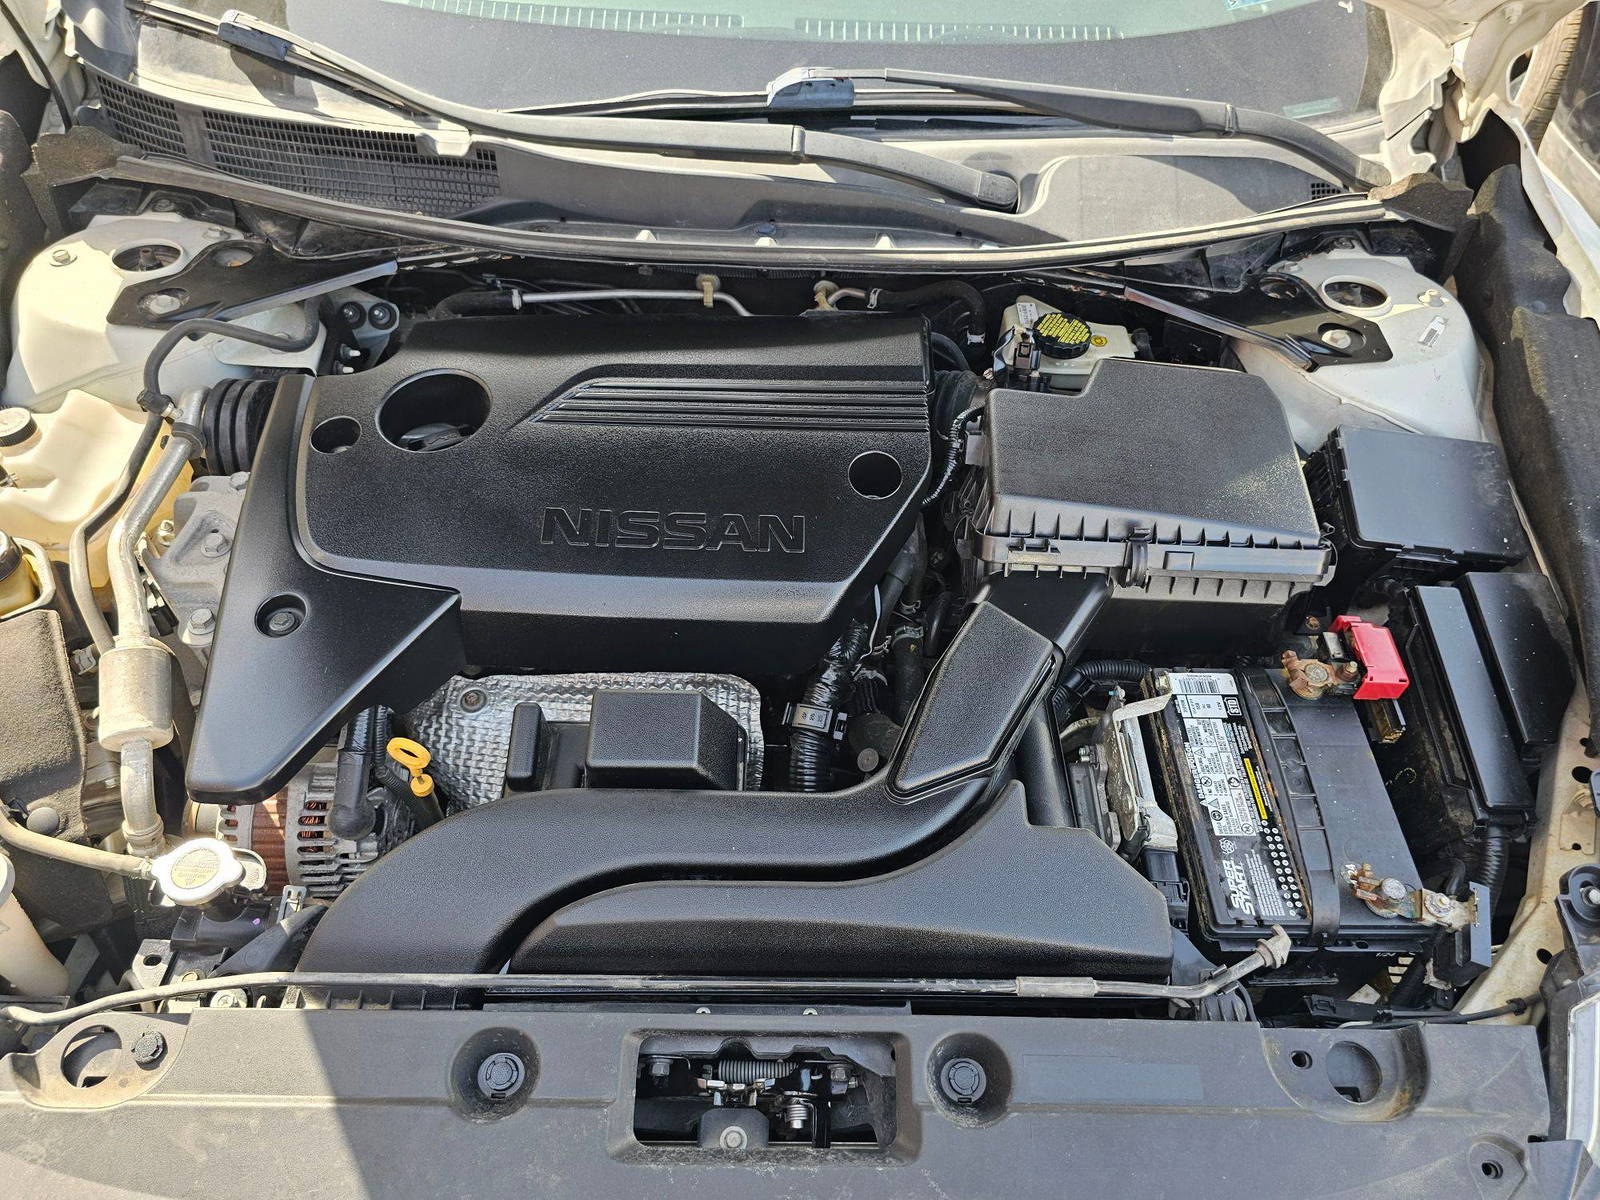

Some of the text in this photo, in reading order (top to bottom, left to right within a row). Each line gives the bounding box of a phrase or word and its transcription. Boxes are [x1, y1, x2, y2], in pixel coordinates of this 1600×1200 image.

[540, 506, 806, 553] NISSAN
[1222, 860, 1241, 909] SUPER
[1231, 859, 1256, 916] START
